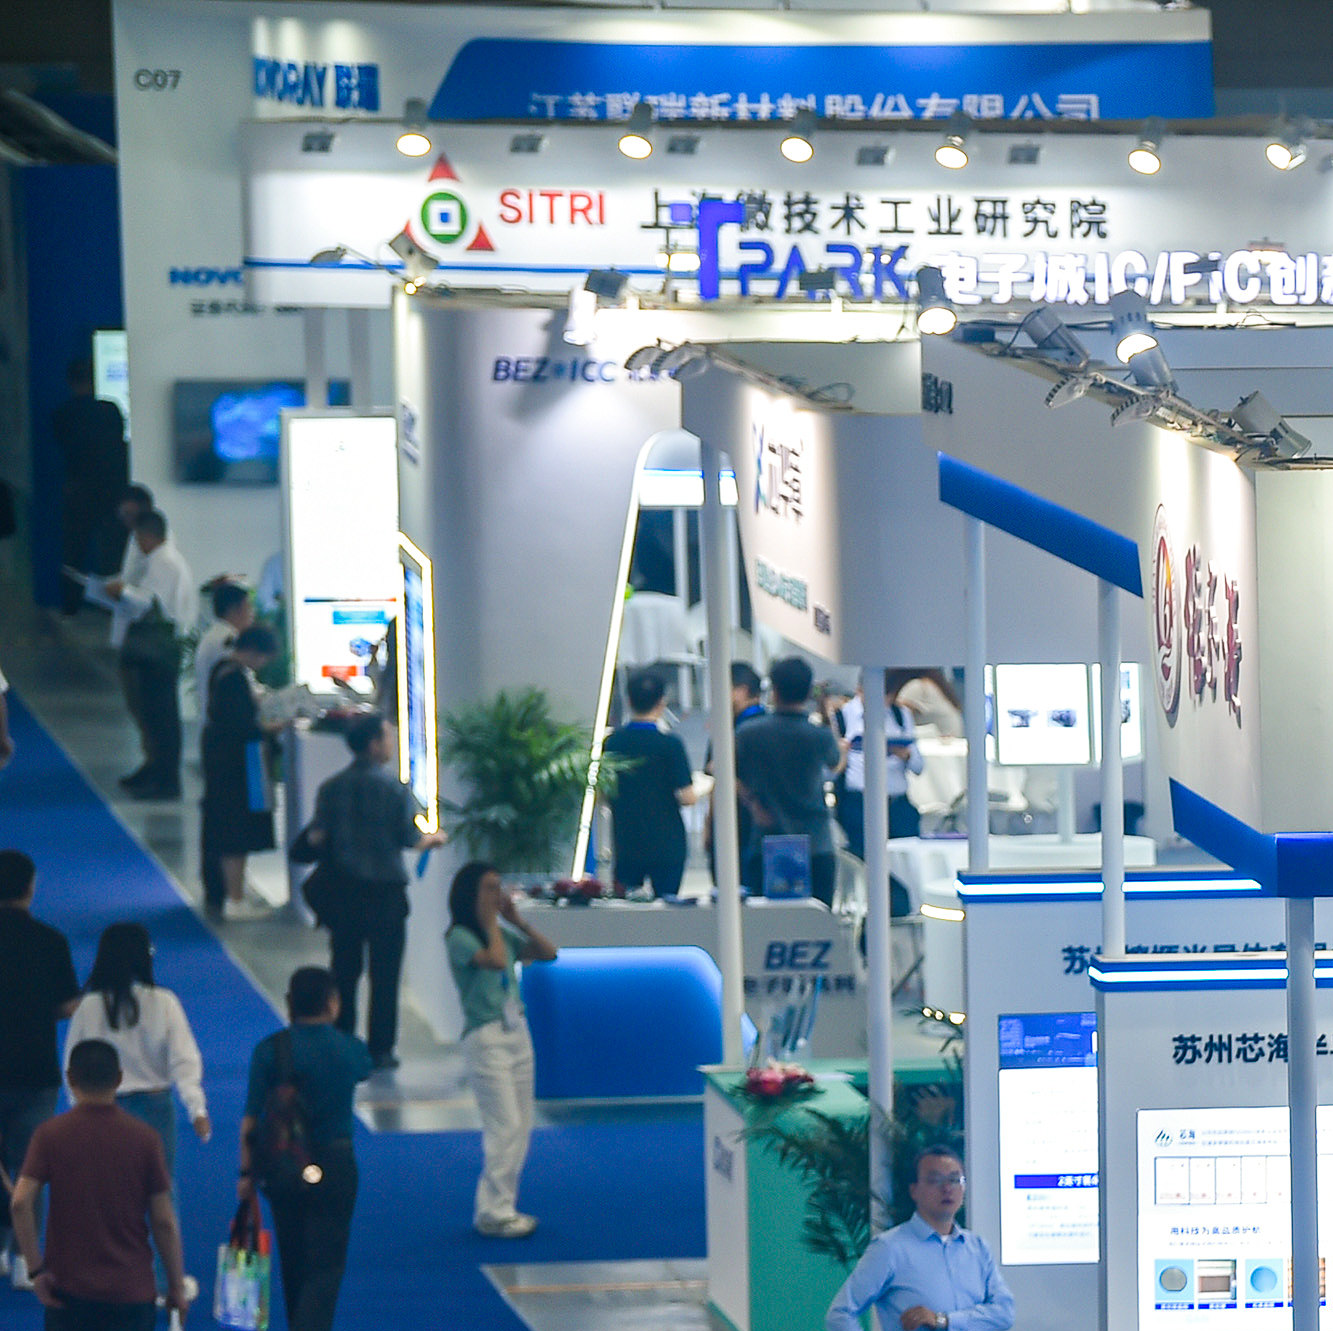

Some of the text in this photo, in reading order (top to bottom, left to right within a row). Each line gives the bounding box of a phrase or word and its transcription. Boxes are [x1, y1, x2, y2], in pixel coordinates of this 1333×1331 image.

[134, 69, 183, 91] C07
[499, 190, 604, 226] SITRI
[640, 187, 1109, 239] 上微技术工业研究院
[765, 940, 832, 971] BEZ
